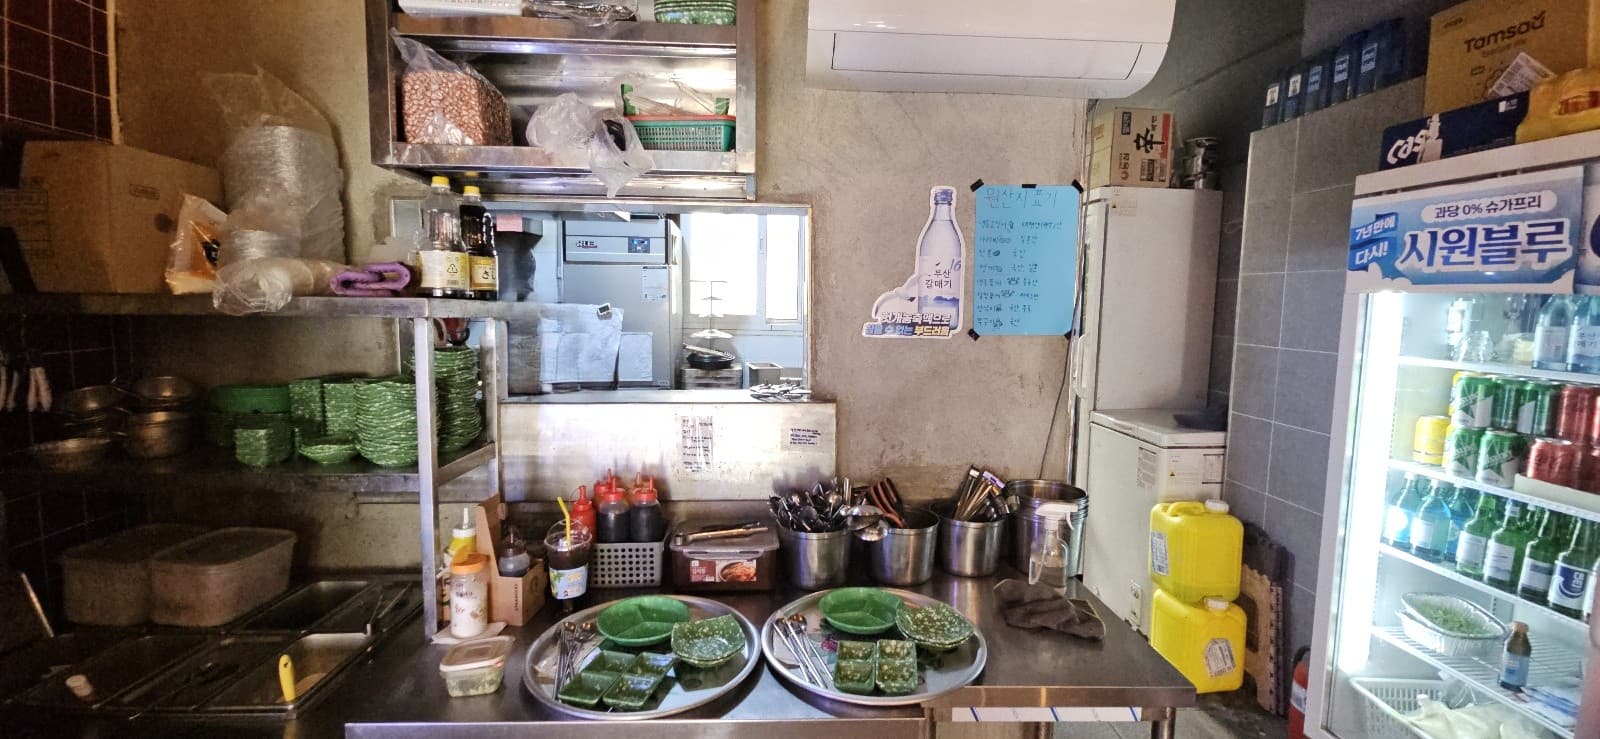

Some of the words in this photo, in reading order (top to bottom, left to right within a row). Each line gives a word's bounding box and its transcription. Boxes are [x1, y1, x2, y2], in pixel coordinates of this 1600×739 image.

[1434, 204, 1459, 219] 과당
[1462, 202, 1483, 215] 0%
[1486, 195, 1542, 214] 슈가프리
[1355, 215, 1396, 239] 7년만에
[1354, 242, 1388, 265] 다시!
[1400, 221, 1568, 267] 시원블루
[925, 279, 952, 289] 갈매기
[933, 269, 951, 279] 부산
[914, 325, 950, 337] 부드러움
